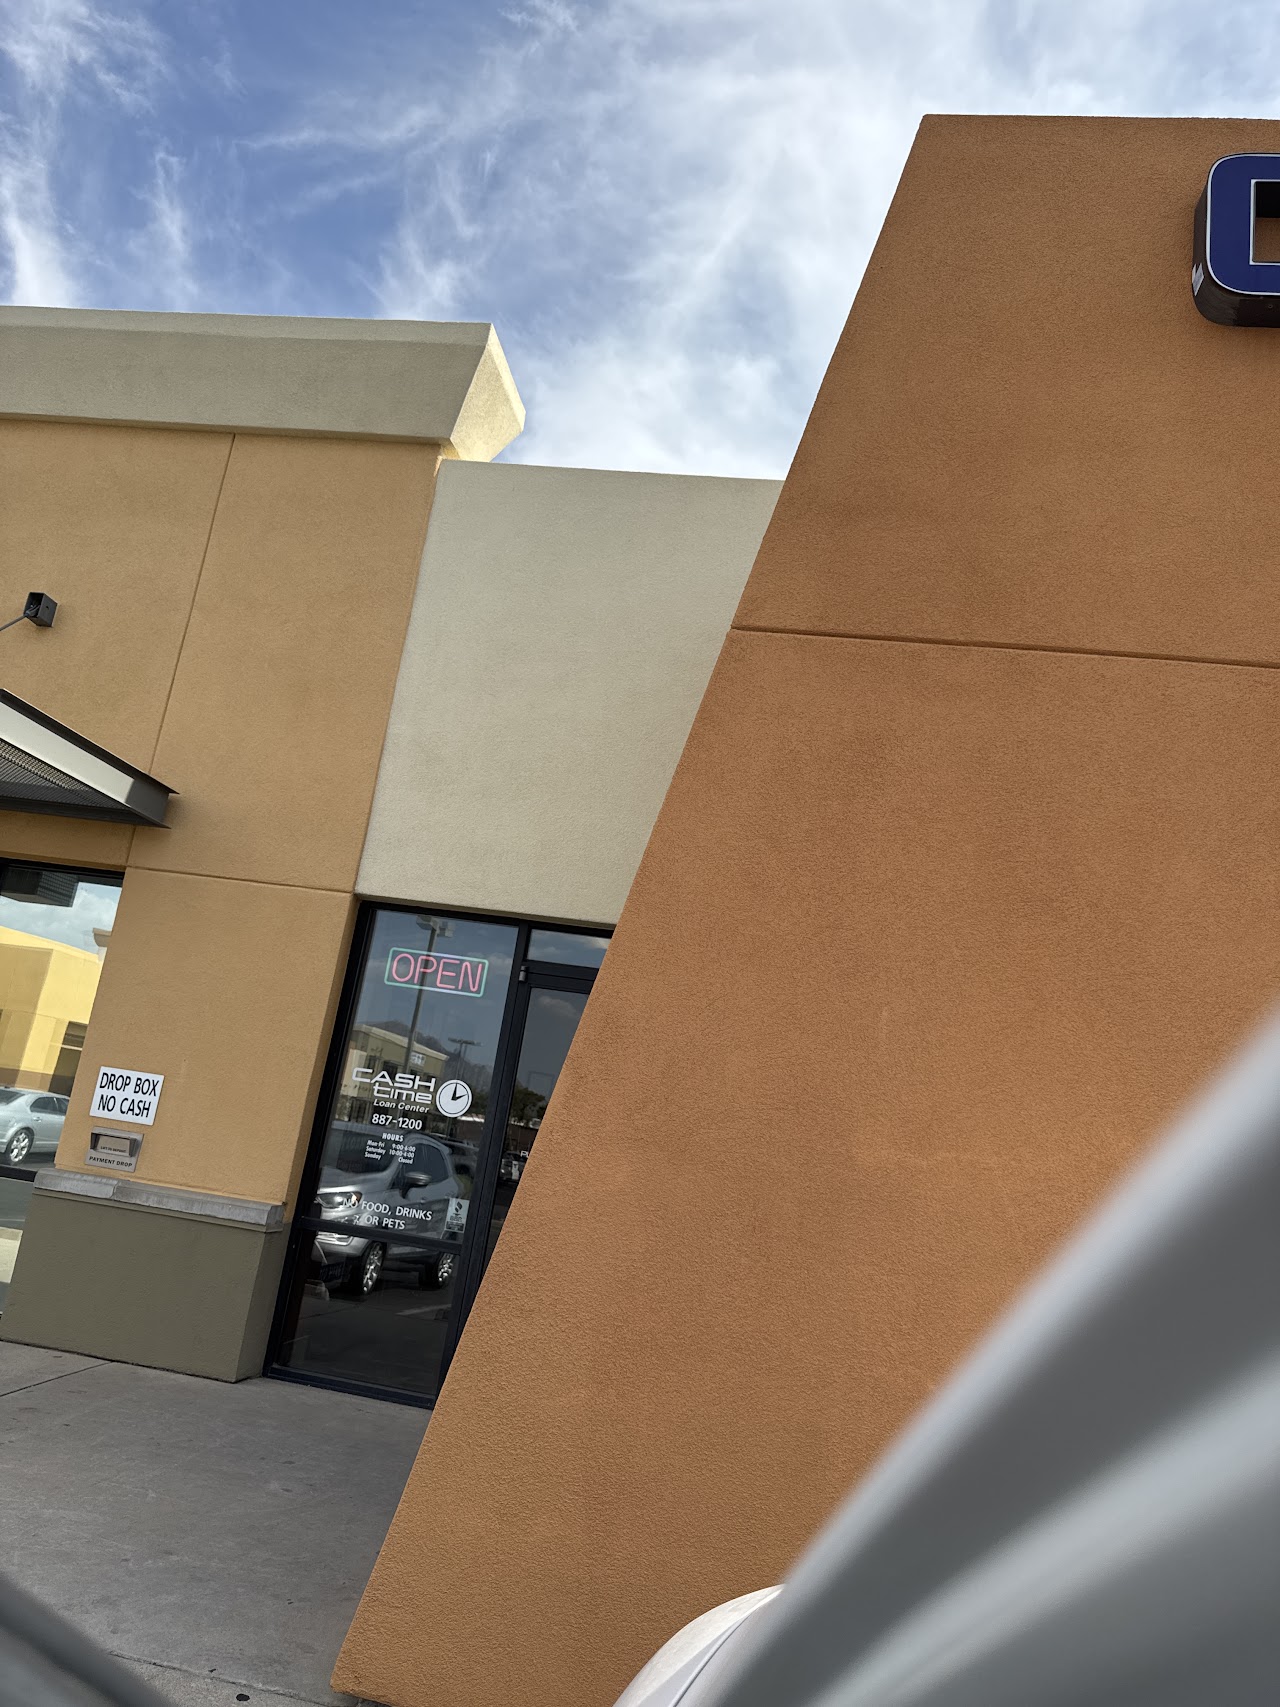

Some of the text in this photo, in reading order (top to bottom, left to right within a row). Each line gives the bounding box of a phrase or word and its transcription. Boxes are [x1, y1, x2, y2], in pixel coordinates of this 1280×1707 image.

[392, 953, 482, 992] OPEN
[100, 1072, 159, 1097] DROP BOX
[352, 1067, 436, 1092] CASH
[373, 1082, 432, 1104] time
[98, 1094, 151, 1118] NO CASH
[373, 1098, 430, 1114] Loan Center
[371, 1113, 422, 1130] 887-1200
[382, 1132, 404, 1142] HOURS
[364, 1152, 413, 1164] Sunday Closed
[366, 1146, 386, 1155] Saturday
[89, 1156, 115, 1164] PAYMENT
[342, 1199, 433, 1221] NO FOOD, DRINKS
[365, 1215, 406, 1230] OR PETS
